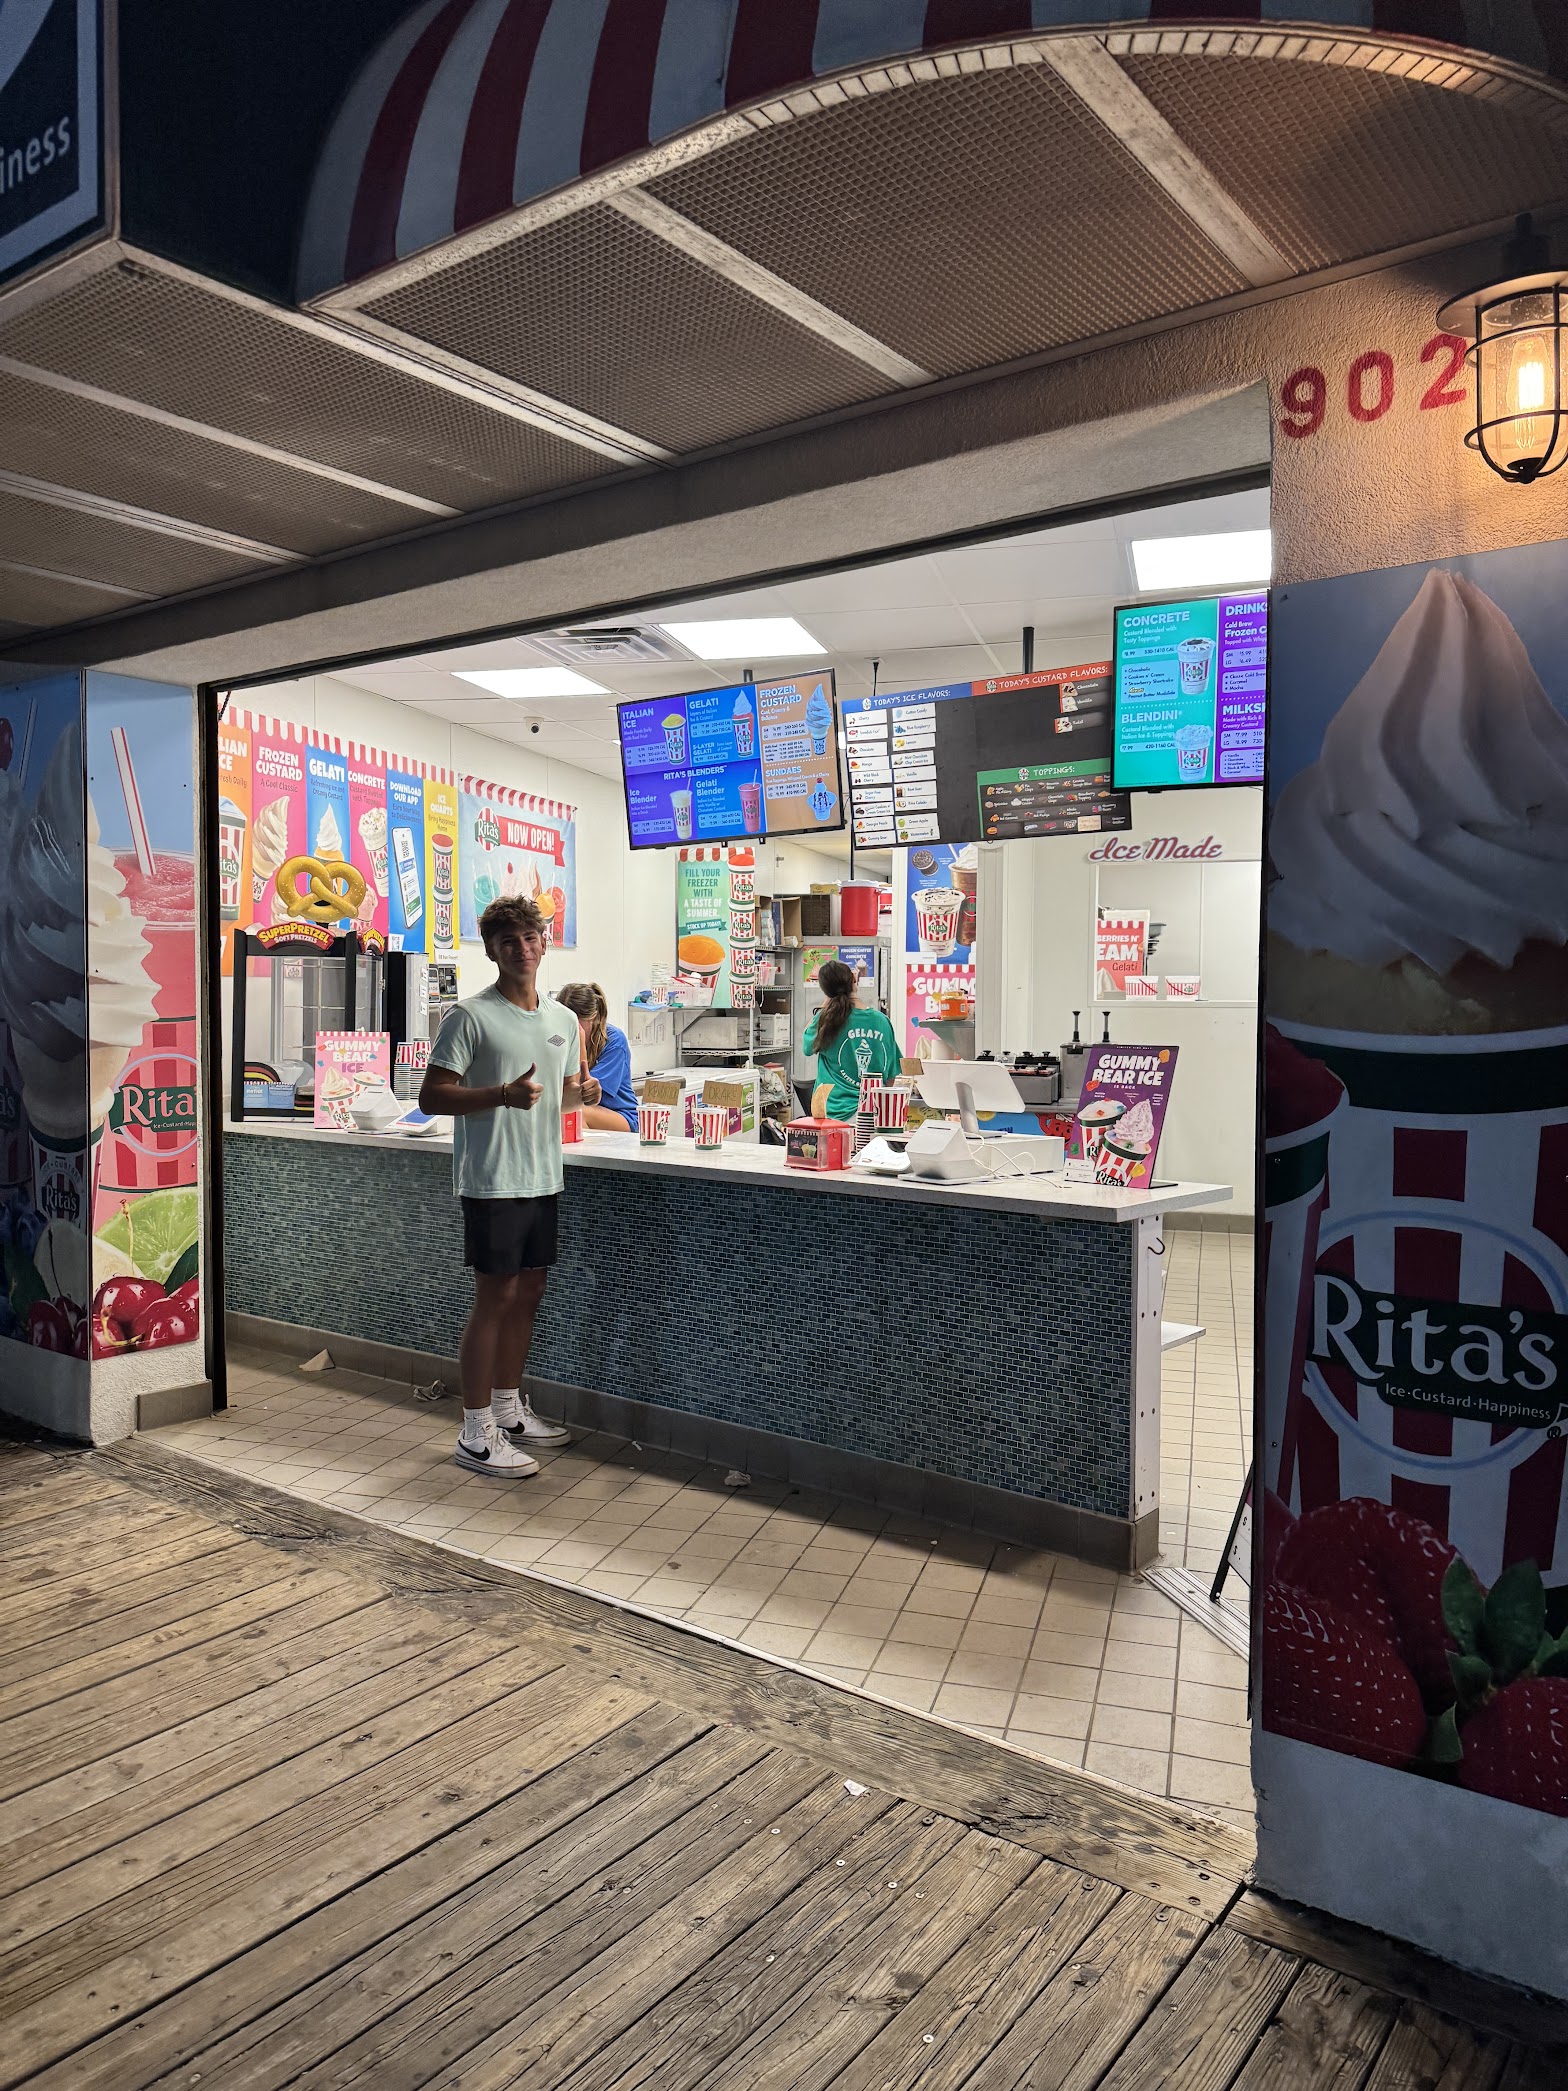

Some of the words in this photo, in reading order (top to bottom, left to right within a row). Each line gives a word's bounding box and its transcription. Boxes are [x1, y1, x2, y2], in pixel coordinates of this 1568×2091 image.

[1278, 333, 1468, 439] 902
[1123, 610, 1190, 628] CONCRETE
[1225, 621, 1237, 629] Cold
[1144, 626, 1165, 634] Blended
[1225, 627, 1257, 638] Frozen
[1138, 635, 1160, 643] Toppings
[999, 678, 1029, 689] TODAY'S
[1032, 673, 1067, 684] CUSTARD
[1070, 665, 1108, 678] FLAVORS:
[759, 684, 796, 699] FROZEN
[874, 697, 900, 706] TODAY'S
[902, 694, 916, 703] ICE
[918, 689, 951, 699] FLAVORS:
[689, 697, 719, 710] GELATI
[760, 694, 802, 708] CUSTARD
[622, 708, 654, 720] ITALIAN
[623, 719, 637, 729] ICE
[1121, 725, 1140, 733] Custard
[259, 746, 299, 767] FROZEN
[255, 760, 303, 782] CUSTARD
[309, 758, 345, 783] GELATI
[663, 770, 686, 780] RITA'S
[765, 766, 802, 777] SUNDAES
[1033, 765, 1075, 776] TOPPINGS:
[260, 779, 265, 787] A
[266, 780, 278, 788] Cool
[278, 782, 298, 793] Classic
[348, 770, 385, 790] CONCRETE
[696, 779, 717, 788] Gelati
[390, 781, 422, 797] DOWNLOAD
[696, 787, 725, 797] Blender
[393, 792, 406, 803] OUR
[407, 795, 419, 805] APP
[437, 793, 446, 804] ICE
[630, 795, 657, 804] Blender
[430, 803, 453, 817] QUARTS
[478, 819, 499, 840] Rita's
[507, 822, 529, 846] NOW
[530, 827, 555, 852] OPEN!
[1089, 837, 1141, 861] Ice
[1144, 835, 1223, 860] Made
[685, 869, 700, 878] FILL
[701, 868, 721, 877] YOUR
[687, 878, 718, 887] FREEZER
[693, 889, 713, 897] WITH
[684, 899, 689, 907] A
[691, 898, 712, 908] TASTE
[713, 898, 722, 906] OF
[686, 908, 719, 918] SUMMER.
[1111, 962, 1138, 972] Gelati
[847, 1028, 884, 1042] GELATI
[324, 1040, 381, 1052] GUMMY
[332, 1051, 373, 1062] BEAR
[1098, 1054, 1162, 1071] GUMMY
[341, 1062, 365, 1073] ICE
[1092, 1069, 1136, 1085] BEAR
[1137, 1071, 1165, 1086] ICE
[709, 1085, 737, 1101] DRAKE
[45, 1183, 77, 1212] Rita's
[1312, 1274, 1558, 1391] Rita's
